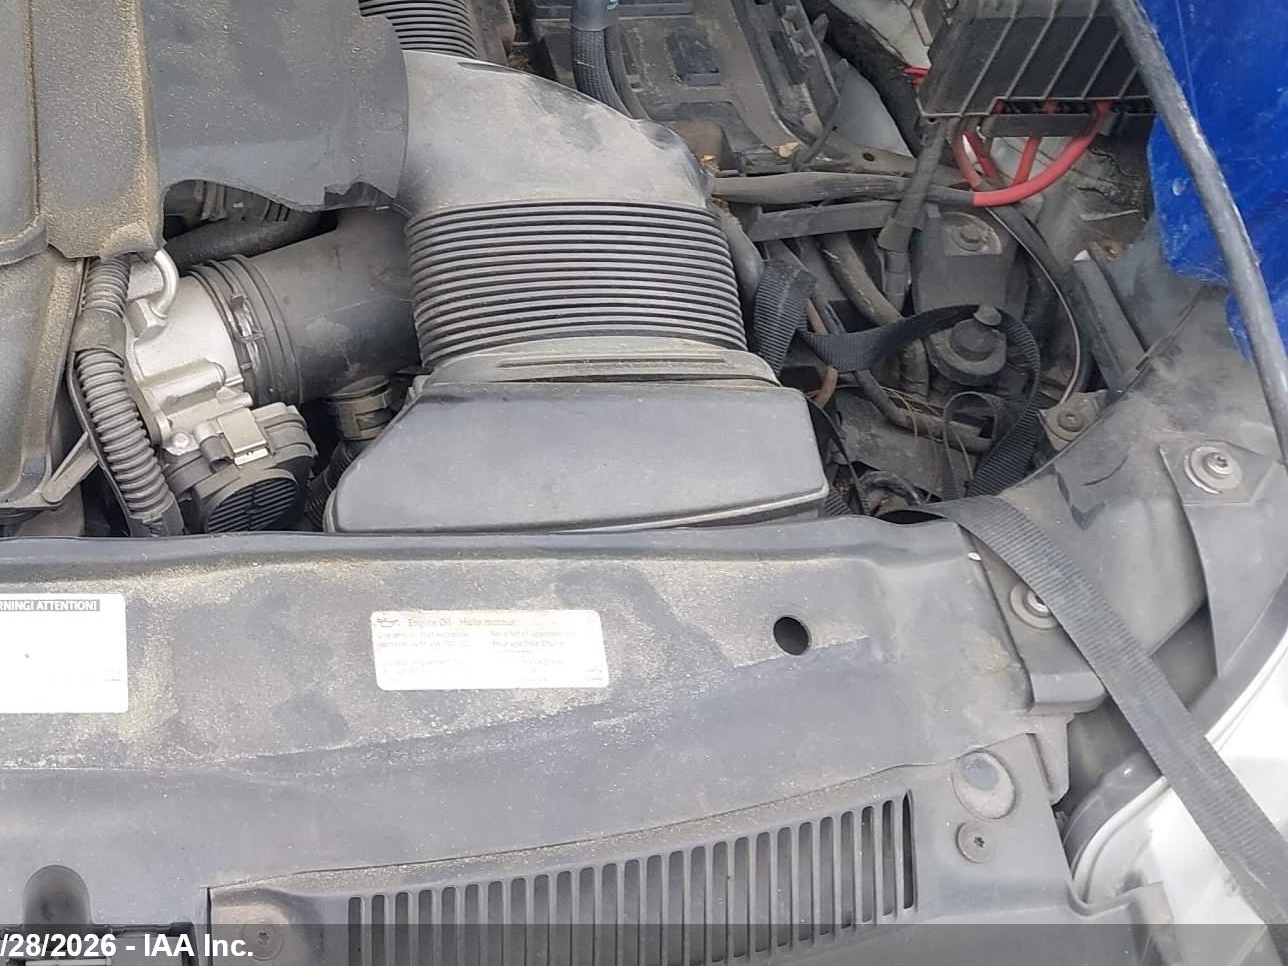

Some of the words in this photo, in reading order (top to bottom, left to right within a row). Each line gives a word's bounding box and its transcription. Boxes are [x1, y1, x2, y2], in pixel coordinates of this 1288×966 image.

[36, 600, 98, 611] ATTENTION!
[408, 618, 437, 629] Engine
[439, 618, 452, 627] Oil
